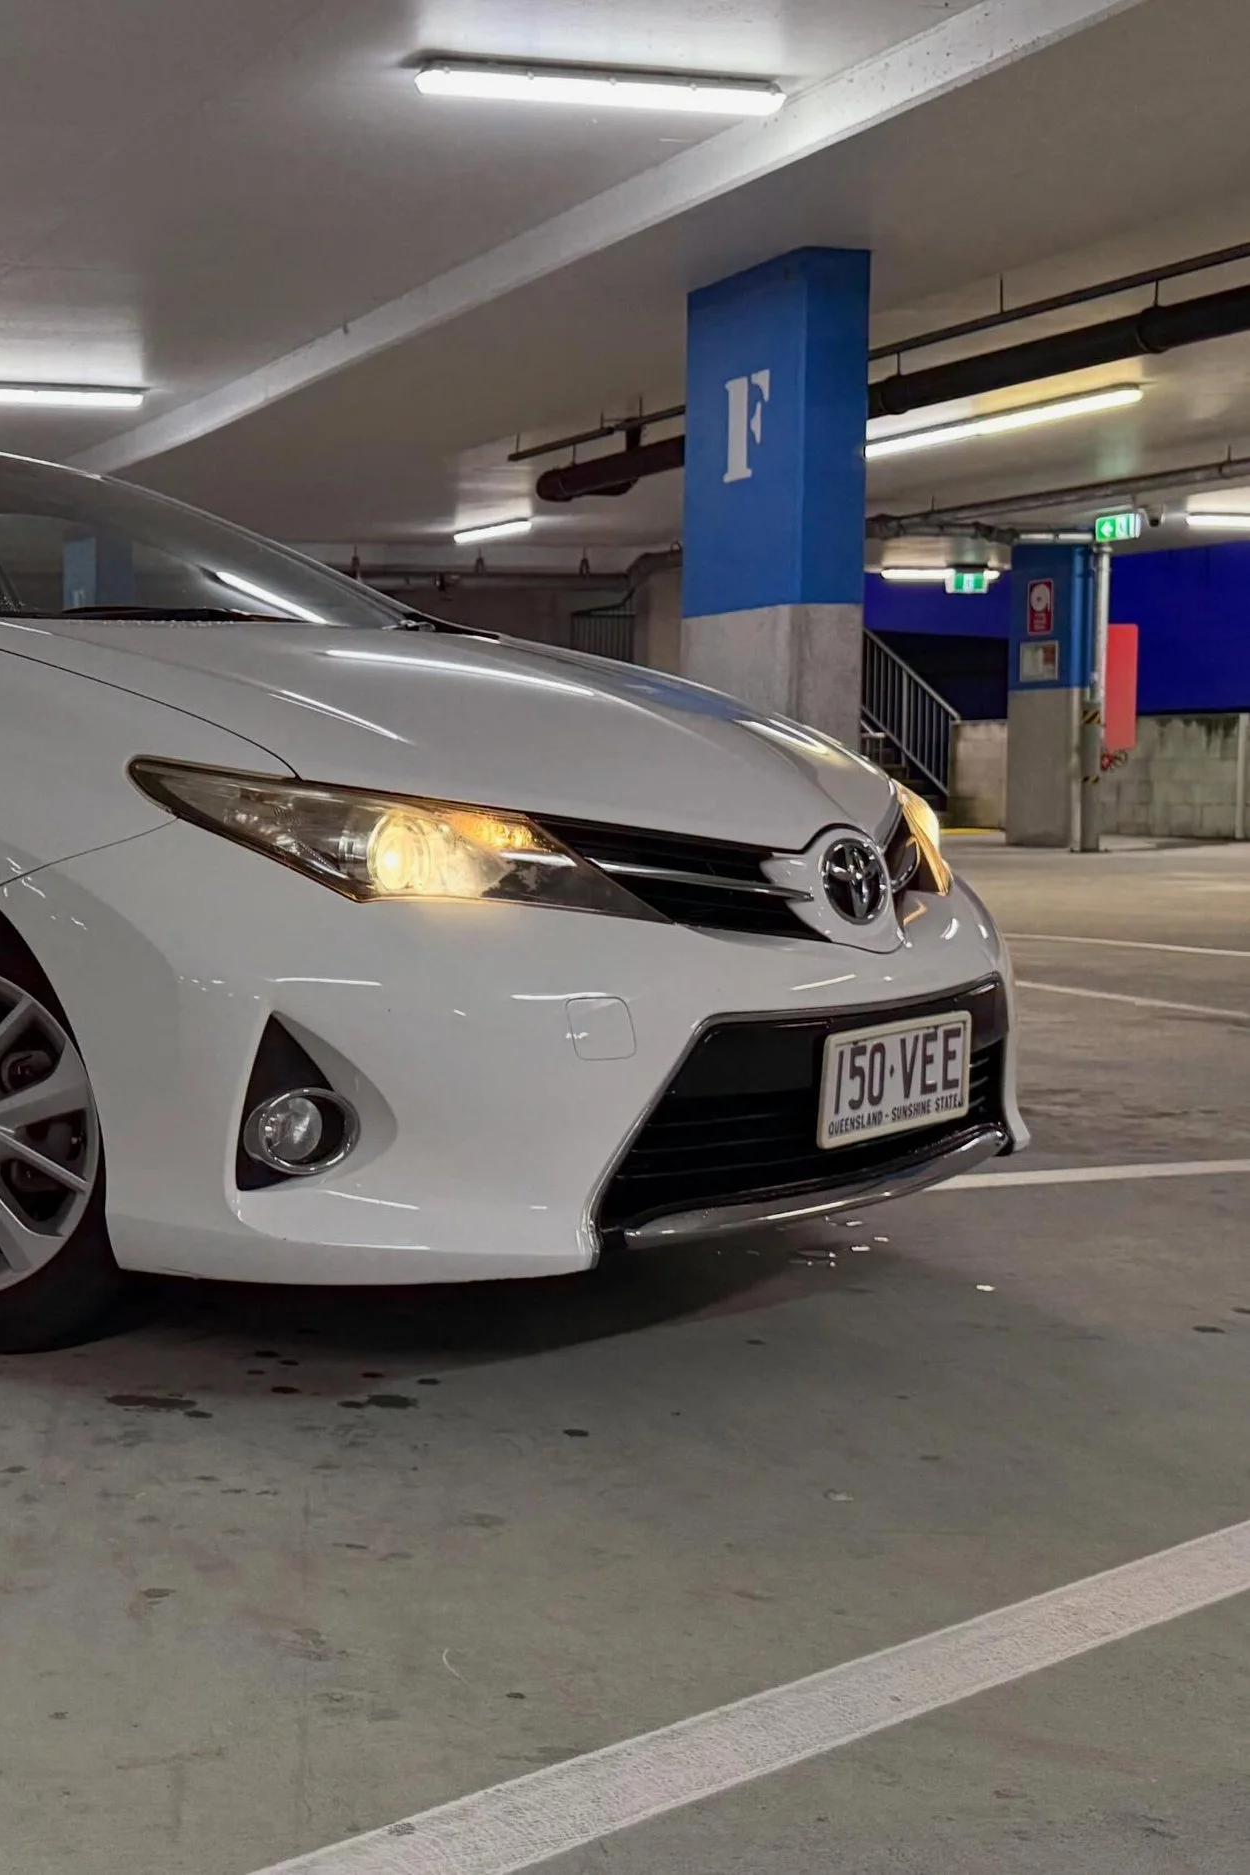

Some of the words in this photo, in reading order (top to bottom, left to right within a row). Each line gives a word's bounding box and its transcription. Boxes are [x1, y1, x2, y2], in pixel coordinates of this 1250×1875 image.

[723, 368, 770, 484] F
[828, 1110, 883, 1136] QUEENSLAND
[891, 1099, 931, 1122] SUNSHINE
[935, 1094, 959, 1112] STATE
